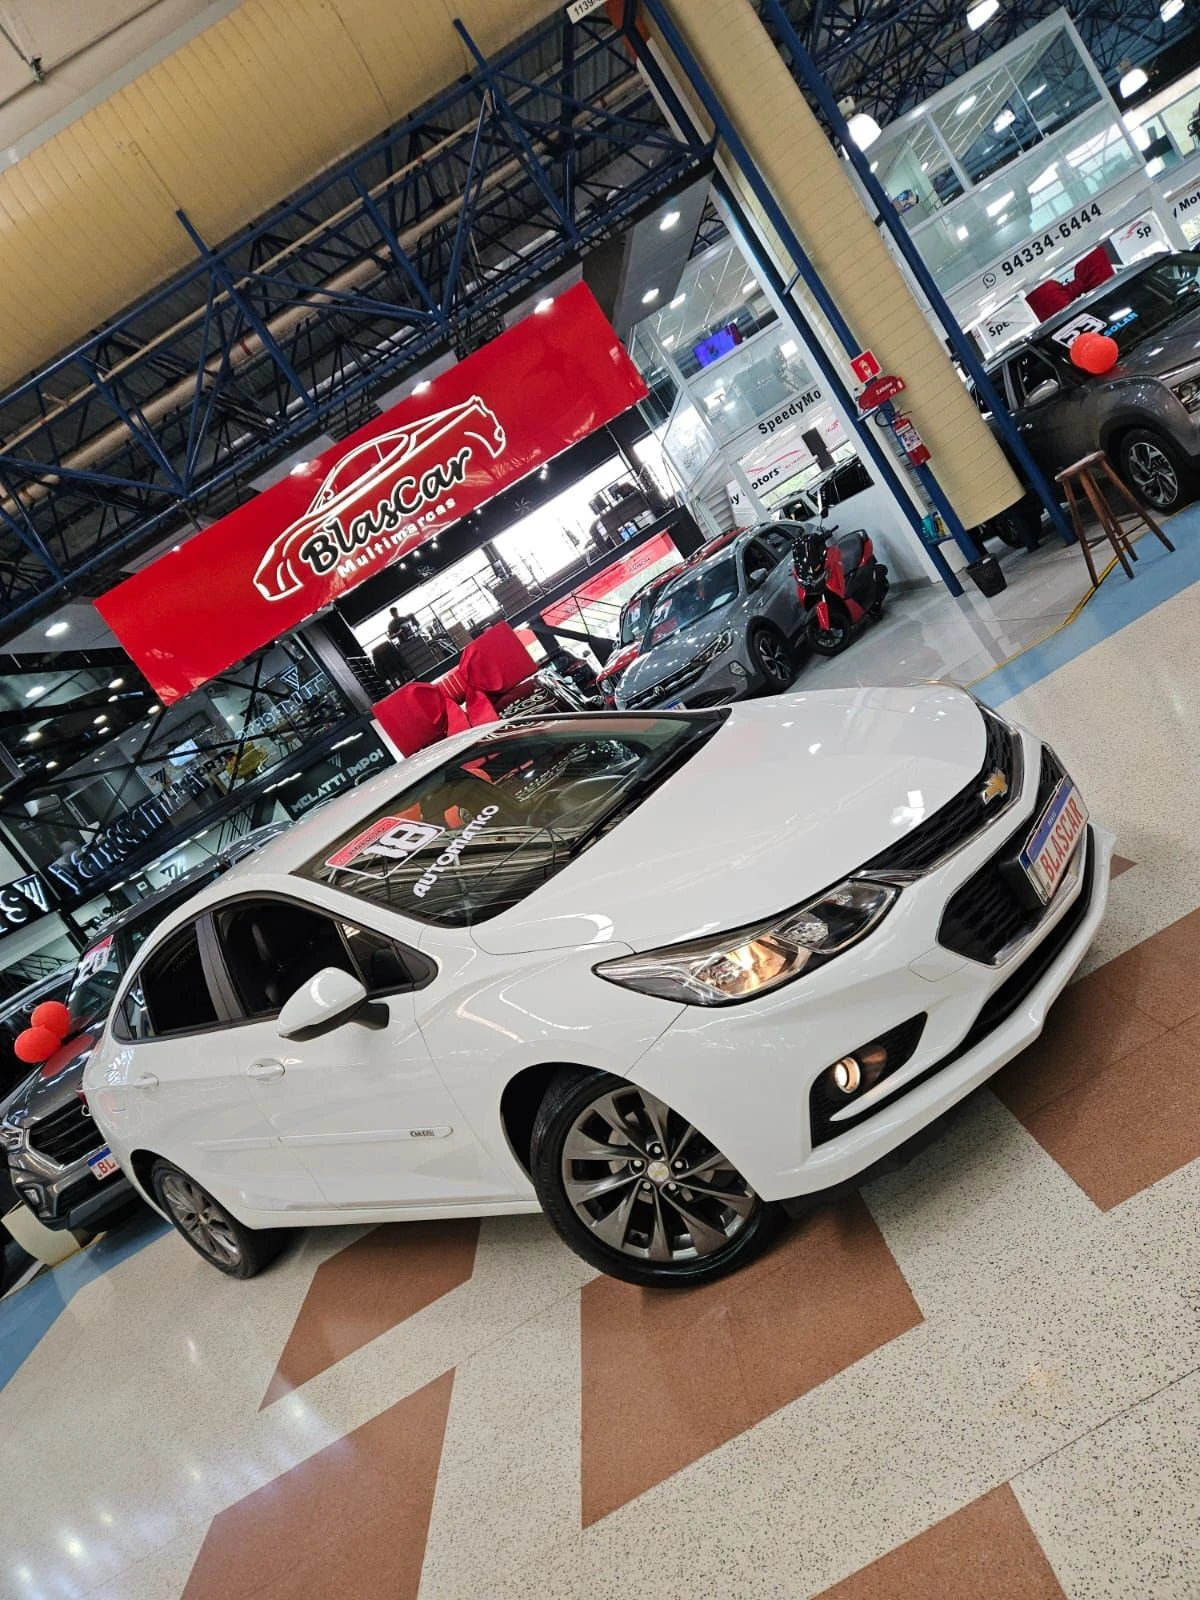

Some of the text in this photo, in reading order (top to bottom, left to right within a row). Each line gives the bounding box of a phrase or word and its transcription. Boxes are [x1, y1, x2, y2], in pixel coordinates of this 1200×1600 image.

[1001, 203, 1101, 276] 94334-6444
[758, 390, 821, 434] SpeedyMo
[300, 447, 471, 575] BlasCar
[336, 498, 456, 578] Multimarcas
[362, 823, 440, 859] 18
[413, 804, 500, 898] AUTOMATICO
[1040, 797, 1083, 882] BLASCAR
[97, 1158, 116, 1174] BL
